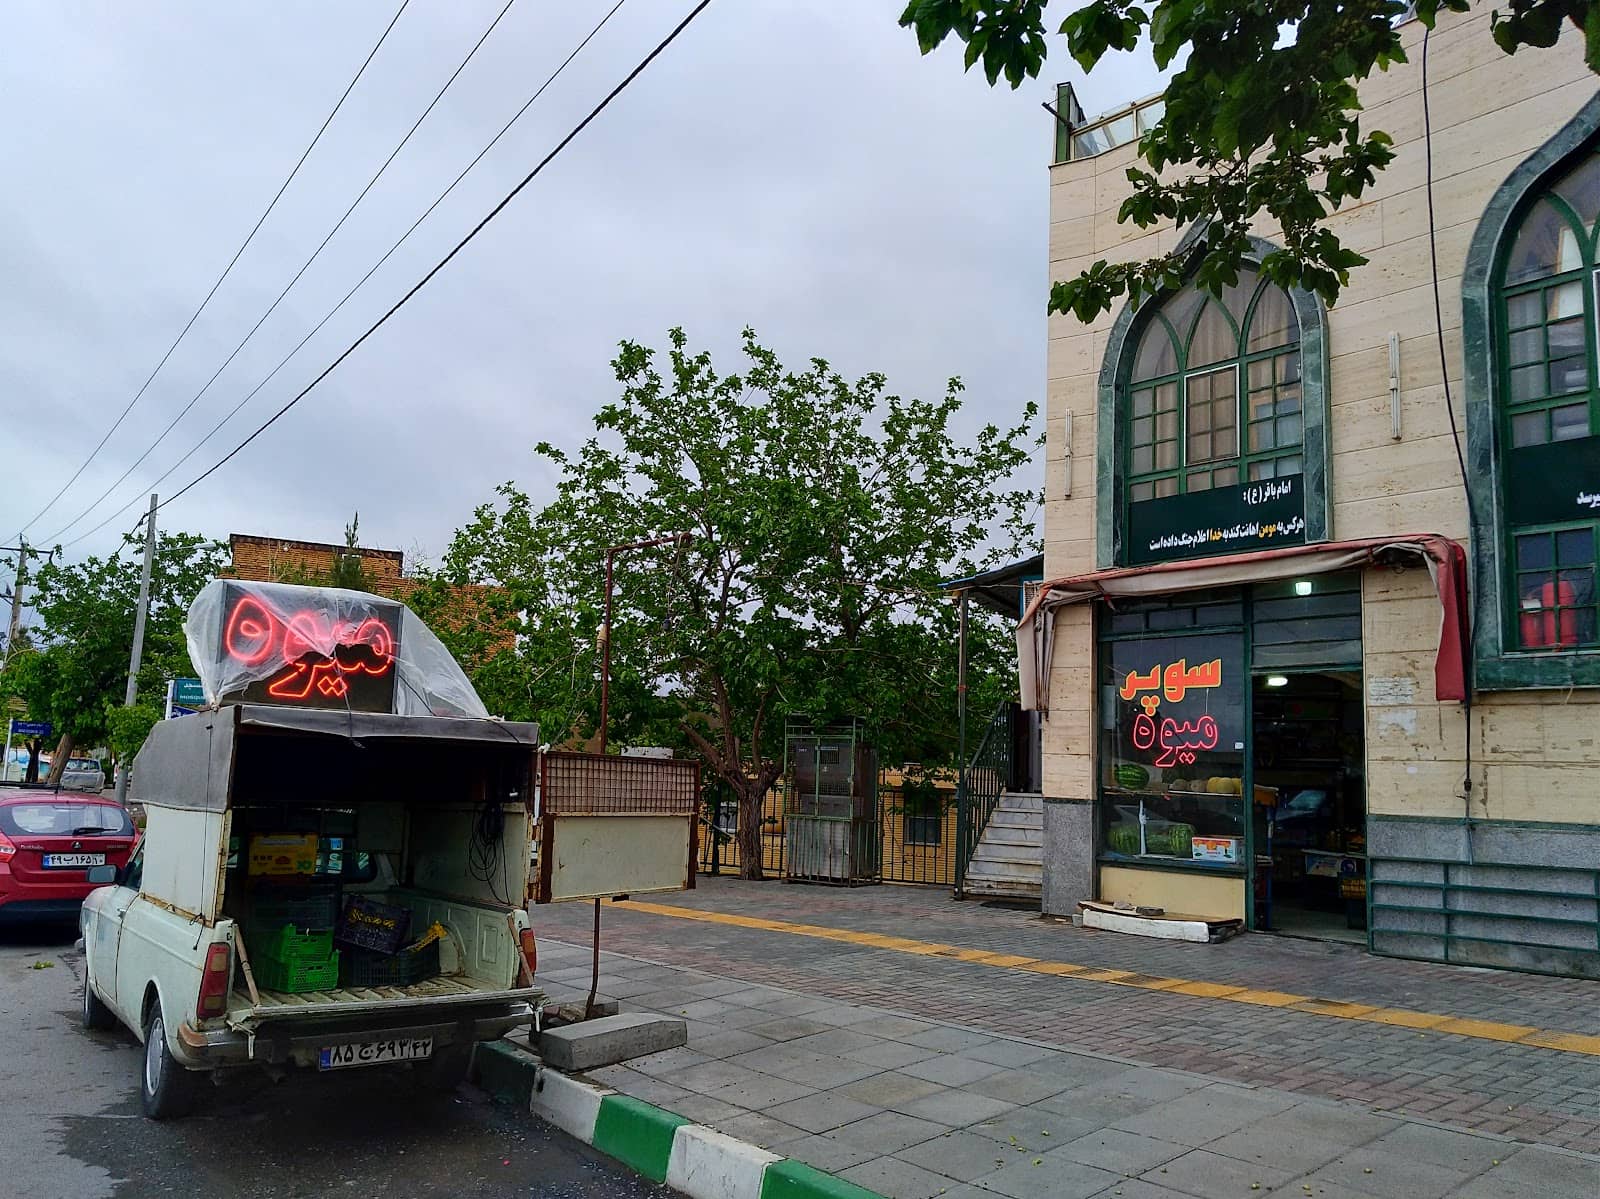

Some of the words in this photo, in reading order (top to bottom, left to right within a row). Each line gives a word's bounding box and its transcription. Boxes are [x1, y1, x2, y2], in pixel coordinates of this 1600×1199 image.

[1263, 482, 1277, 502] باقر
[1276, 480, 1291, 500] امام
[1209, 528, 1222, 542] خدا
[1240, 521, 1259, 537] اهانت
[1178, 532, 1193, 548] جنگ
[226, 595, 393, 699] میوه
[1120, 657, 1222, 716] سوپر
[1133, 713, 1219, 768] میوه
